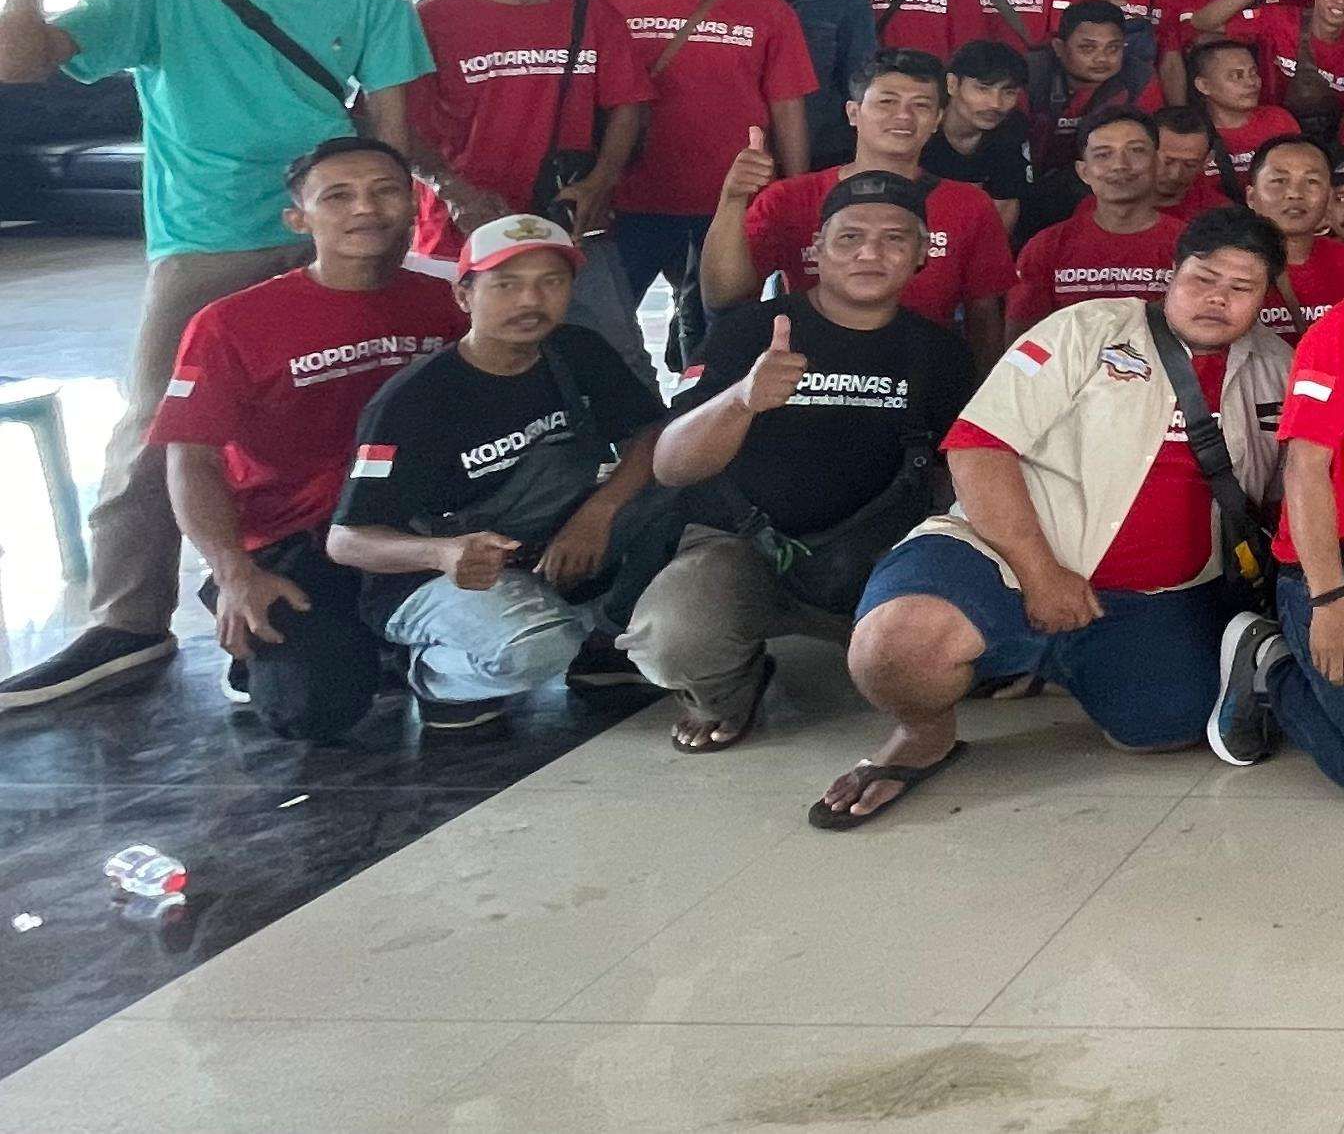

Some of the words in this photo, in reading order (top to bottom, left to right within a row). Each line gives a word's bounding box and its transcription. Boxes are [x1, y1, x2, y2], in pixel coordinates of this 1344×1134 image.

[627, 18, 729, 35] OPDANAS
[732, 25, 755, 39] #6
[1054, 268, 1154, 284] KOPDARNAS
[291, 335, 417, 375] KOPDARNS
[797, 372, 893, 395] PDARNAS
